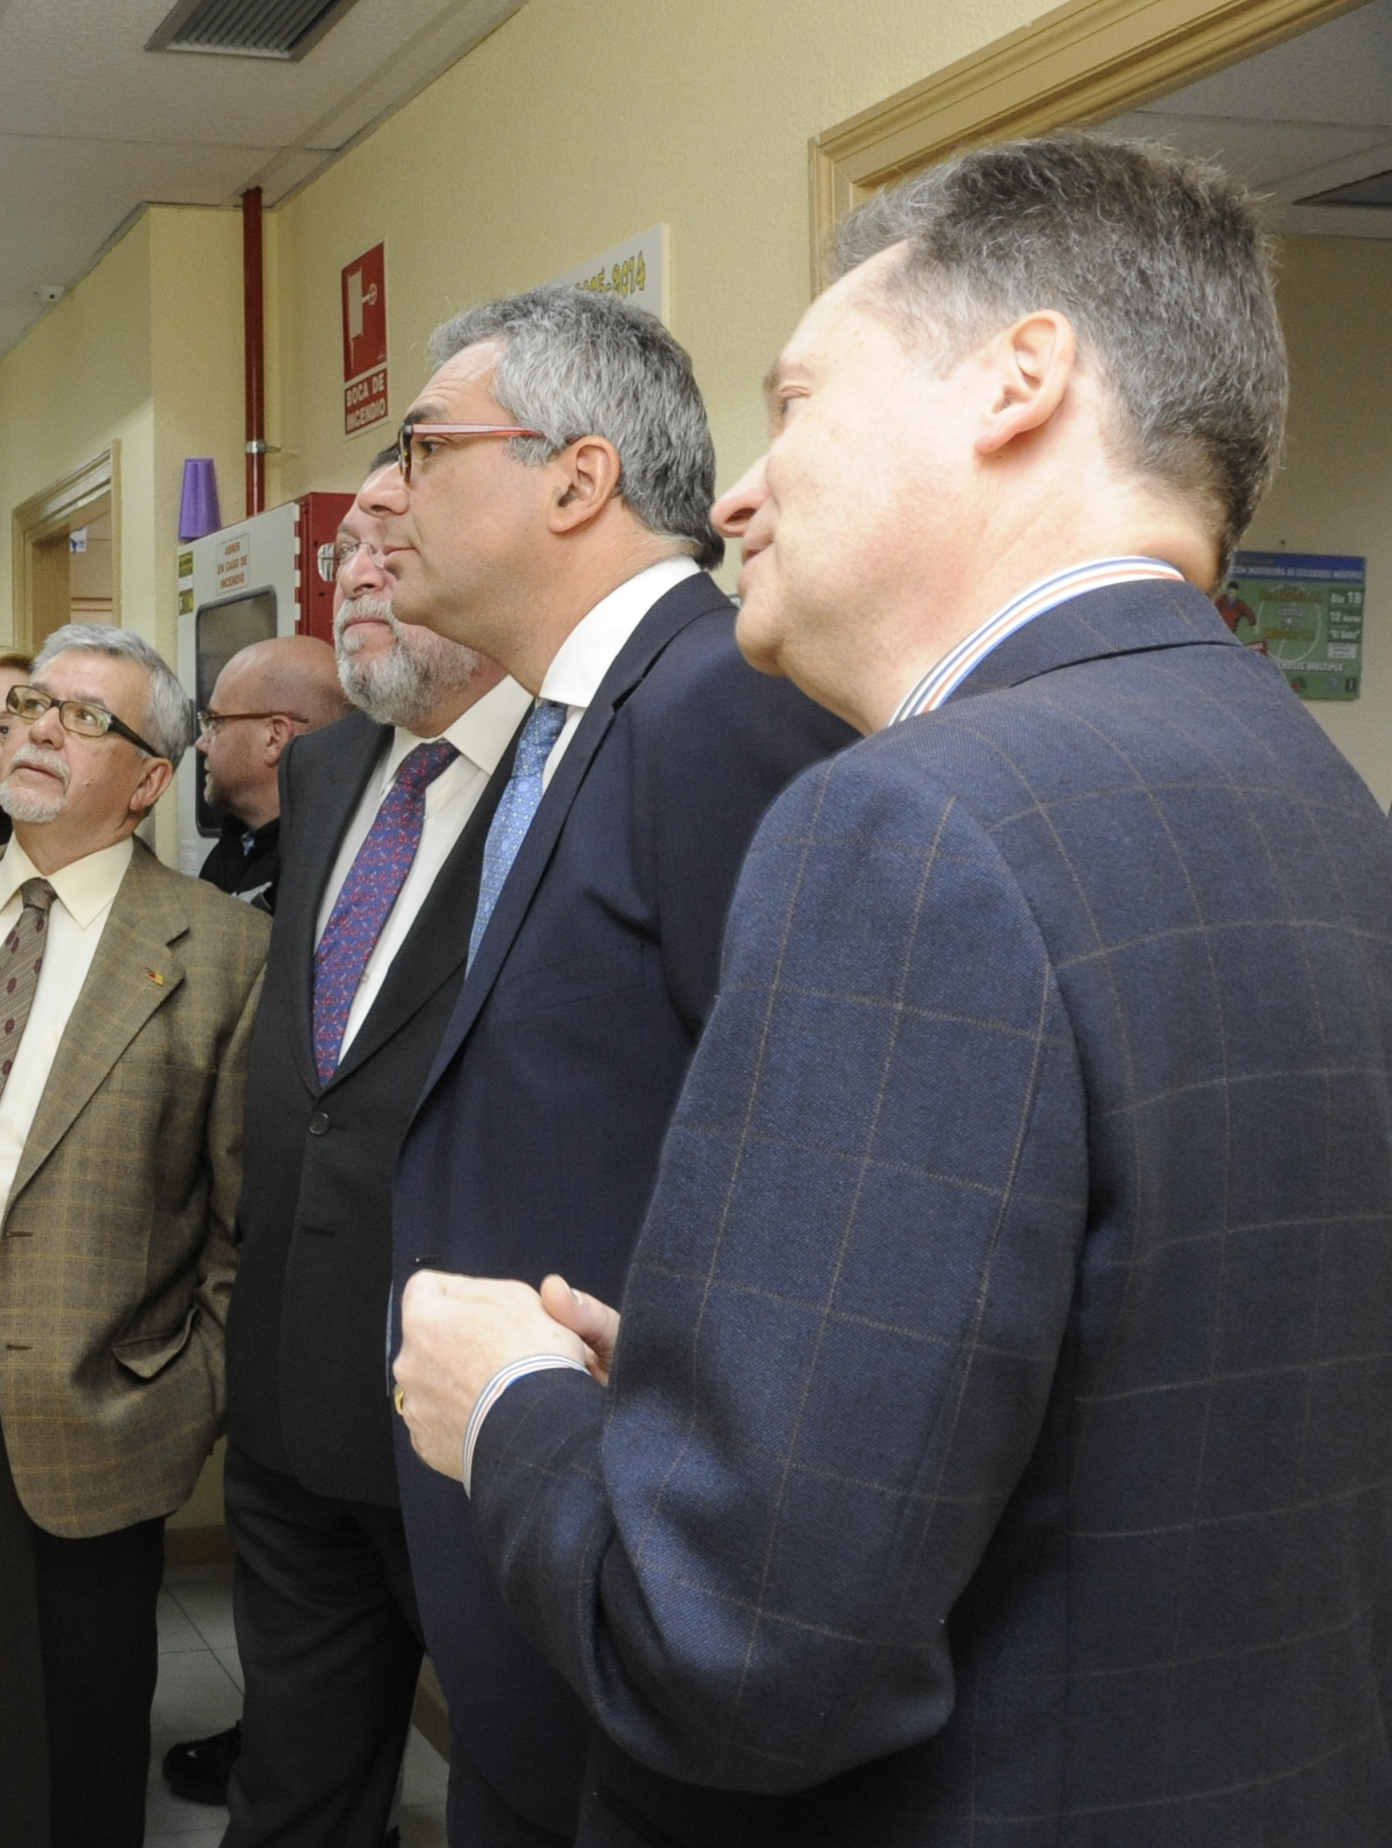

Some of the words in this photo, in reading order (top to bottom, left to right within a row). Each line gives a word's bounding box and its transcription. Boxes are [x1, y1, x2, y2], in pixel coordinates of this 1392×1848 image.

[346, 380, 369, 407] BOCA
[372, 371, 385, 395] DE
[346, 398, 386, 432] INCENDIO
[217, 563, 225, 575] EN
[225, 557, 240, 572] CASO
[240, 554, 248, 567] DE
[220, 572, 245, 589] INCENDIO
